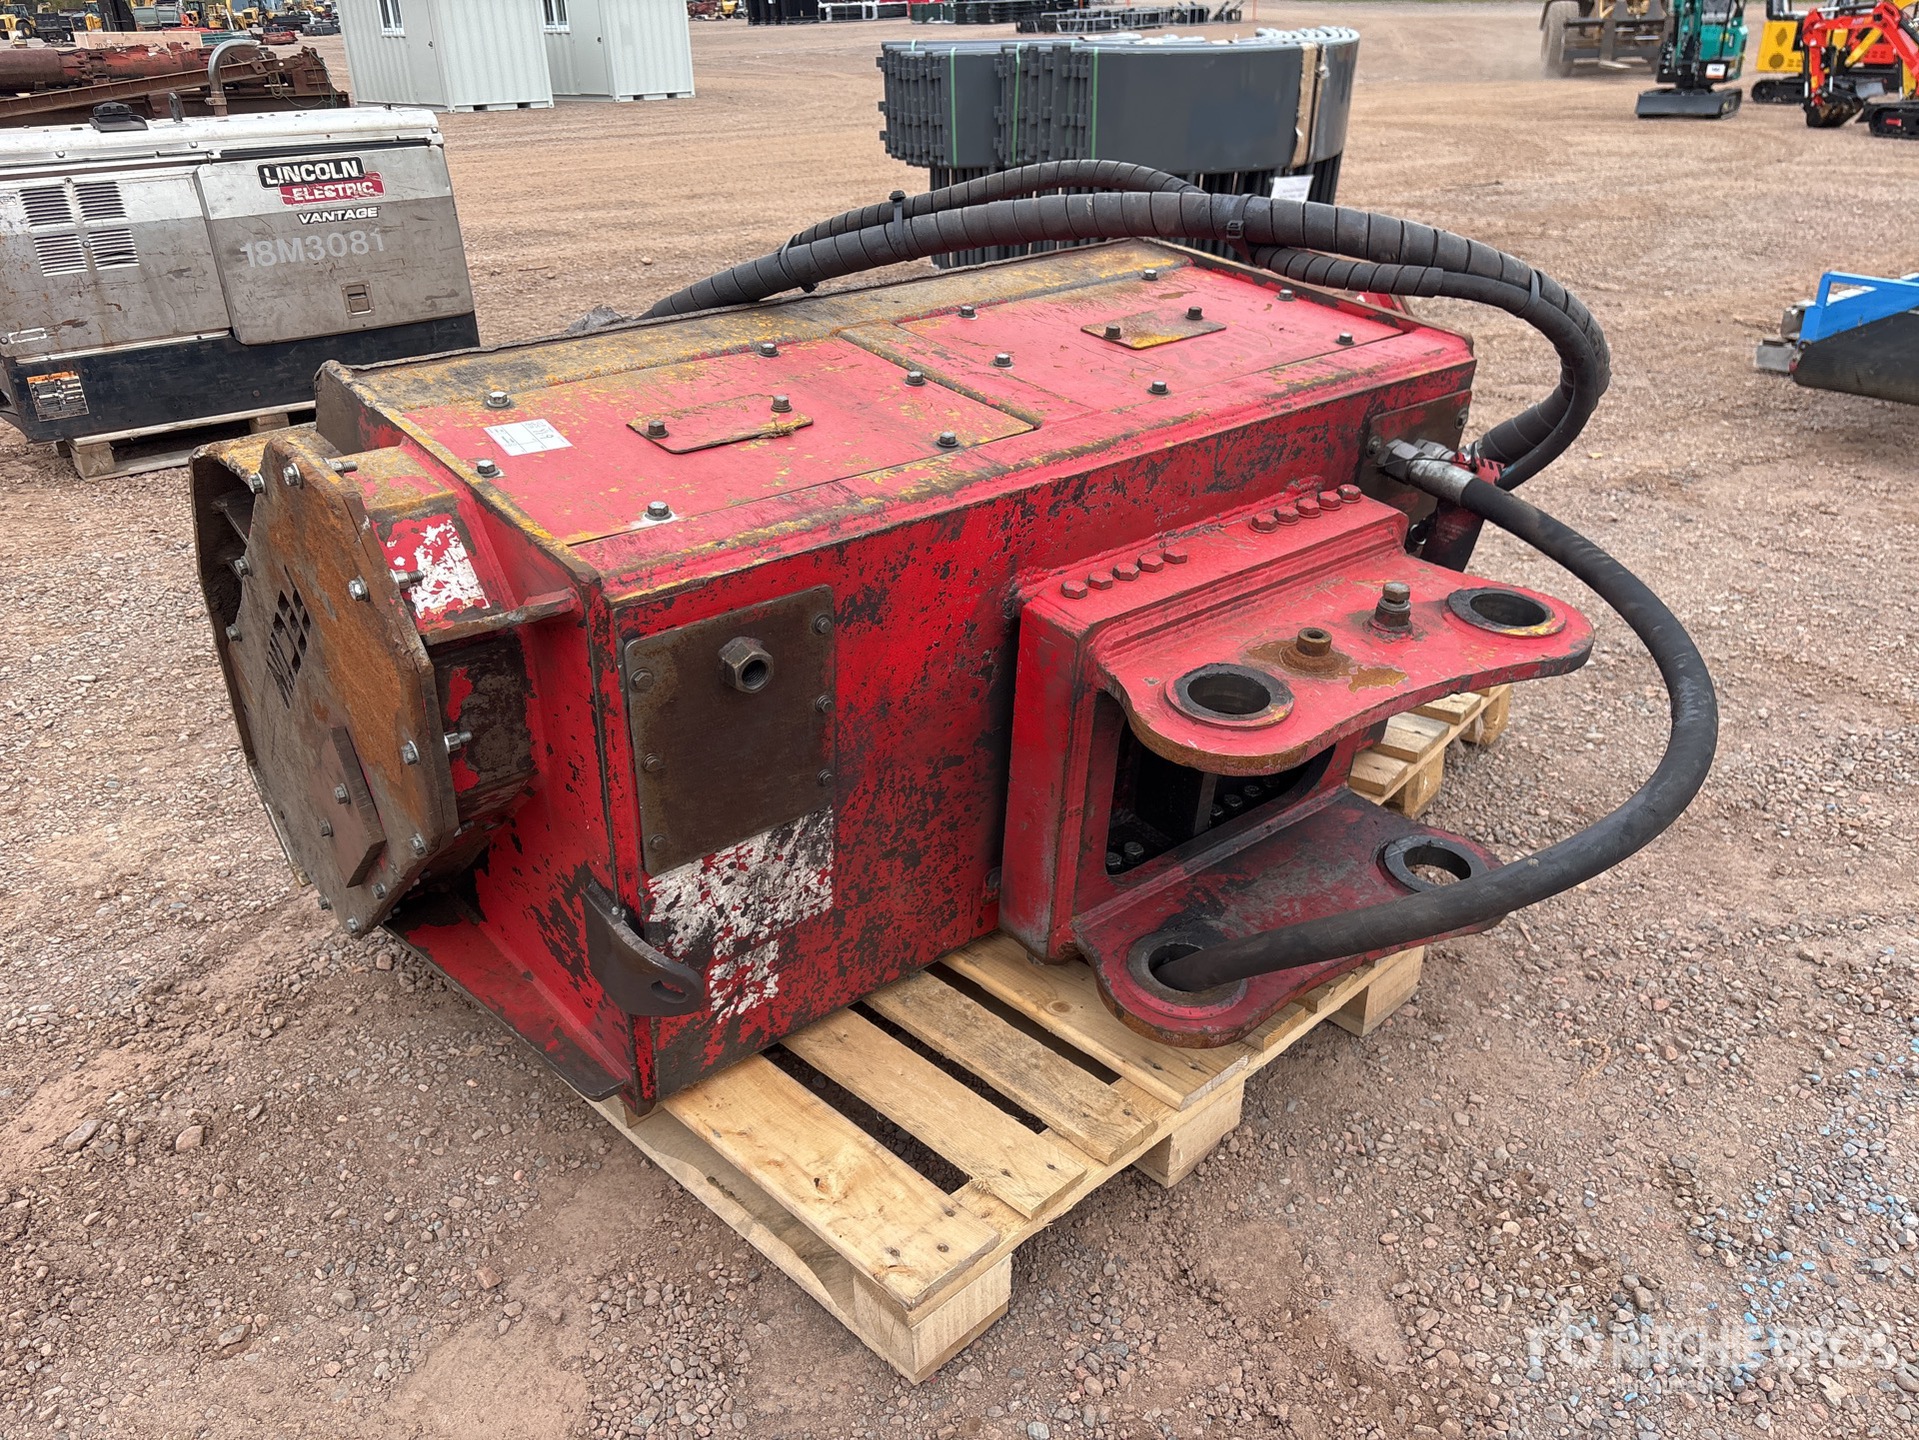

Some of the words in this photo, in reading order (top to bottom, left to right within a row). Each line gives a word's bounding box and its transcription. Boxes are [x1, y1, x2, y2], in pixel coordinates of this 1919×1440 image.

[263, 160, 360, 186] LINCOLN
[291, 181, 376, 202] ELECTRIC
[298, 207, 379, 225] VANTAGE
[239, 227, 385, 268] 18M3081
